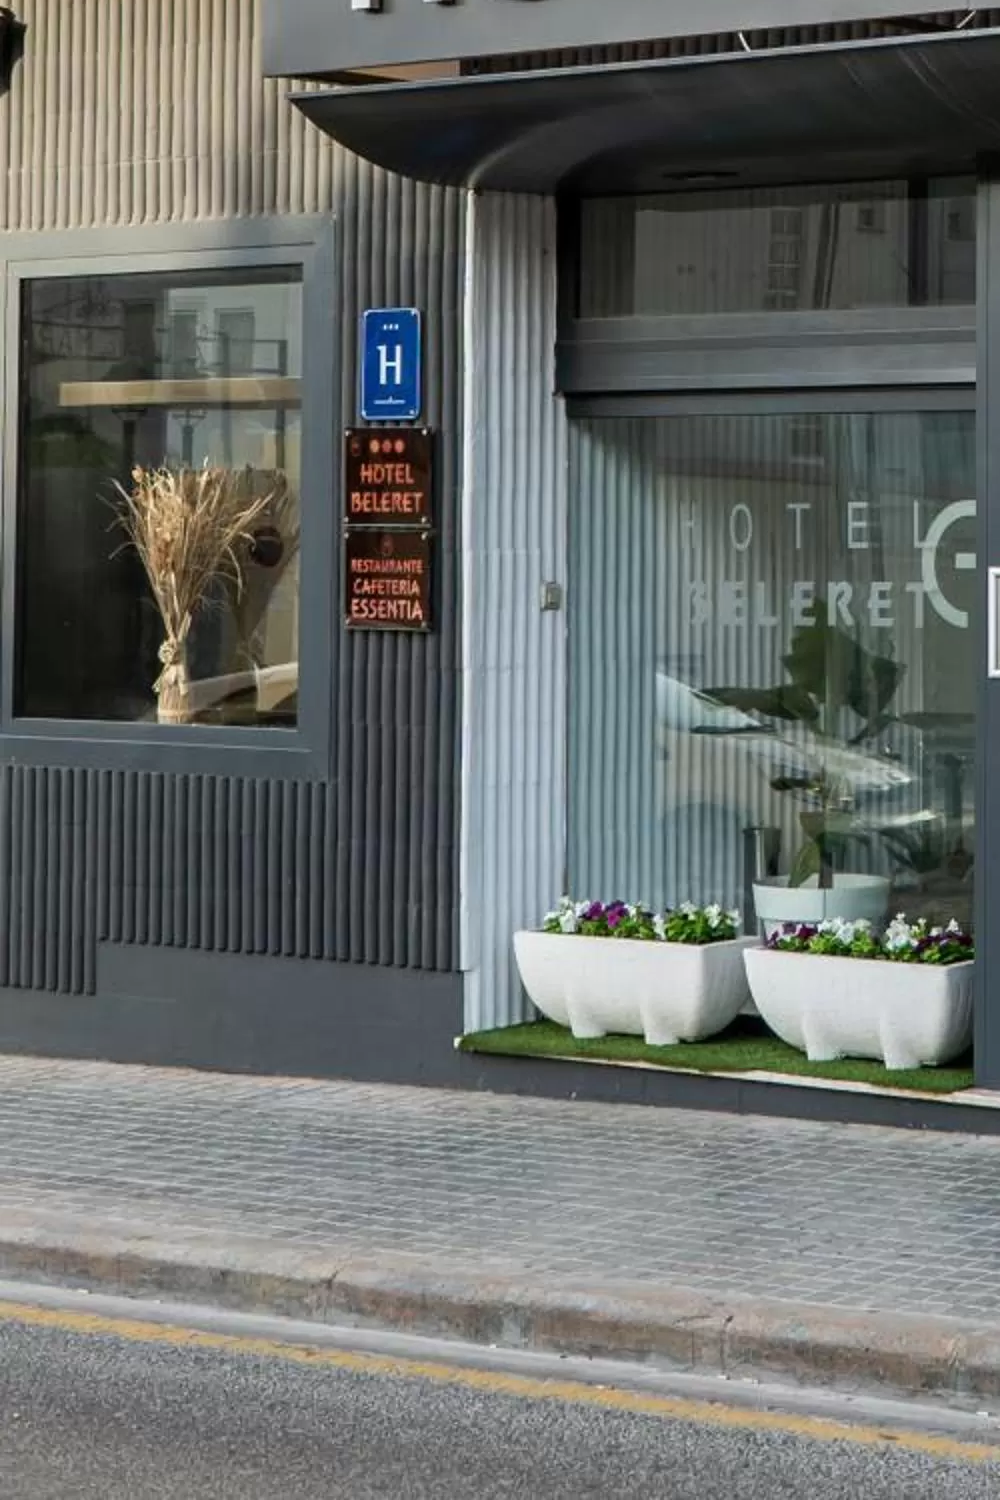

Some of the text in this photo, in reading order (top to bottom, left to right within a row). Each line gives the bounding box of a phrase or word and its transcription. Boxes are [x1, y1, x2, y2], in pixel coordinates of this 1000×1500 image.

[376, 344, 402, 385] H
[361, 463, 415, 485] HOTEL
[351, 492, 424, 513] BELERET
[681, 501, 936, 551] HOTEL
[351, 558, 424, 574] RESTAURANTE
[351, 598, 423, 620] ESSENTIA
[688, 581, 928, 628] BELERET
